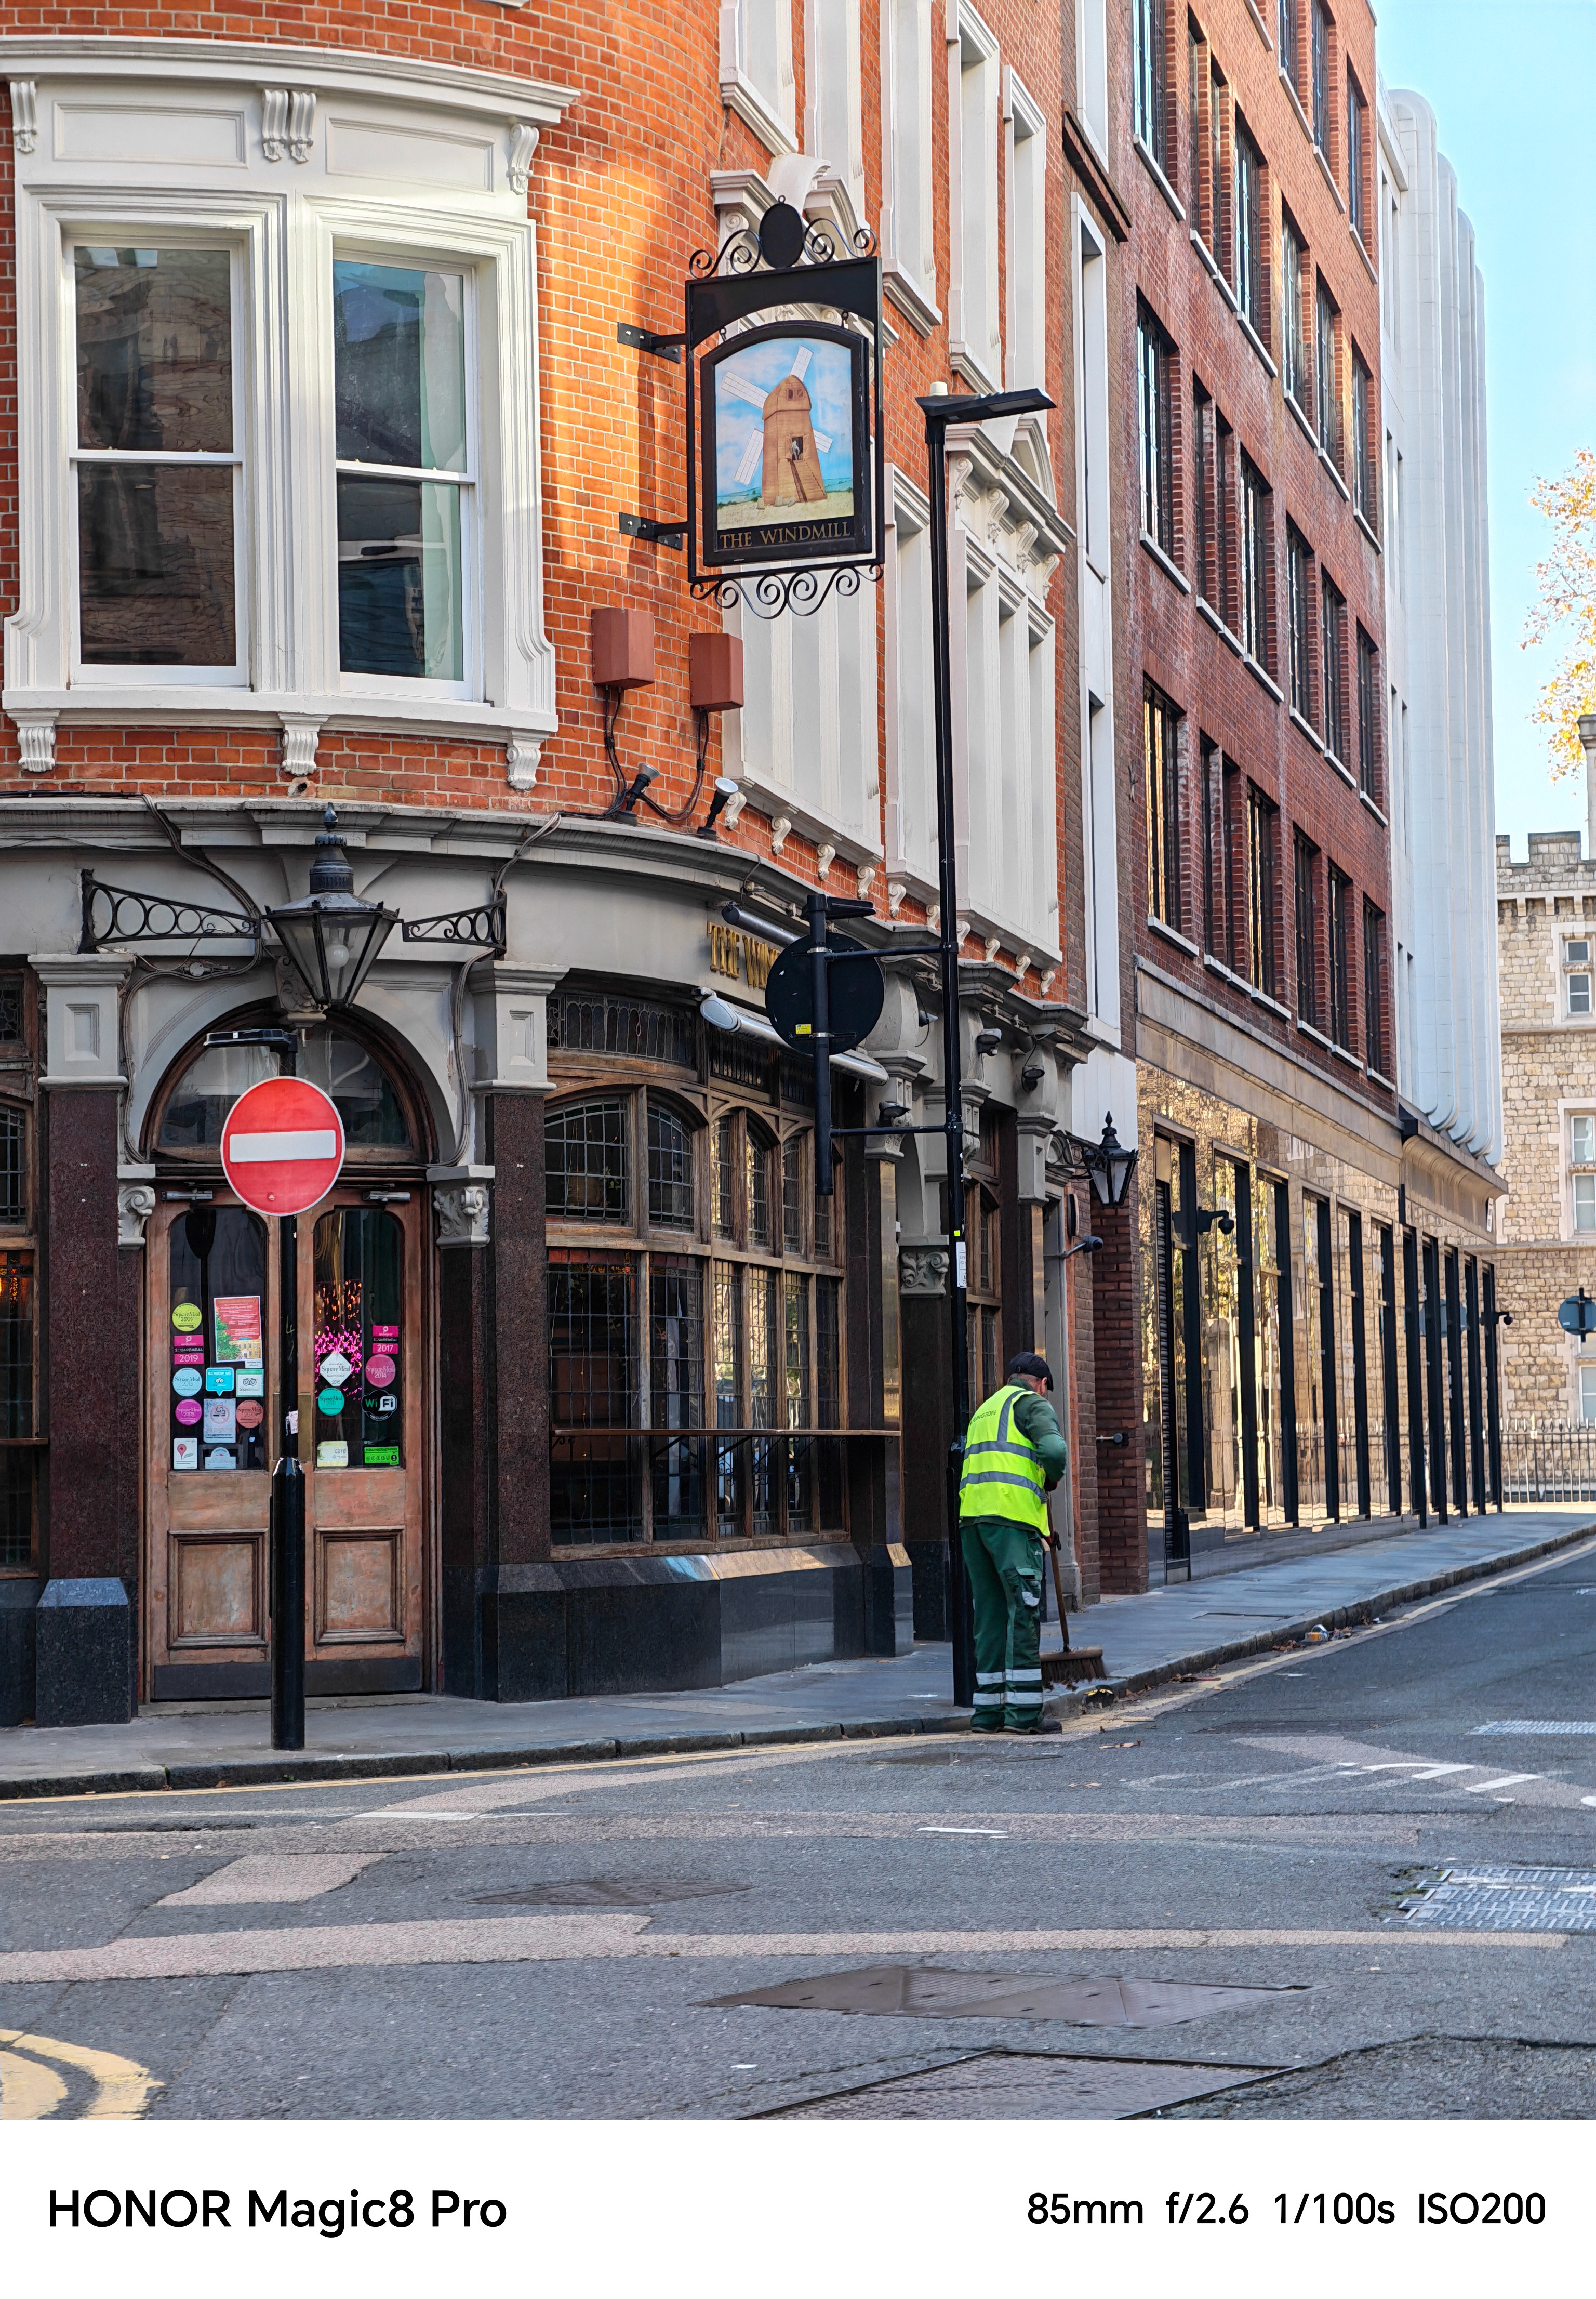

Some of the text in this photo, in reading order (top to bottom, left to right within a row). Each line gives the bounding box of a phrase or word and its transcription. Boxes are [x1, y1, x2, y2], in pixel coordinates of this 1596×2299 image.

[720, 521, 851, 549] THE WINDMILL
[707, 921, 740, 981] THE
[377, 1344, 394, 1352] 2017
[179, 1354, 198, 1363] 2019
